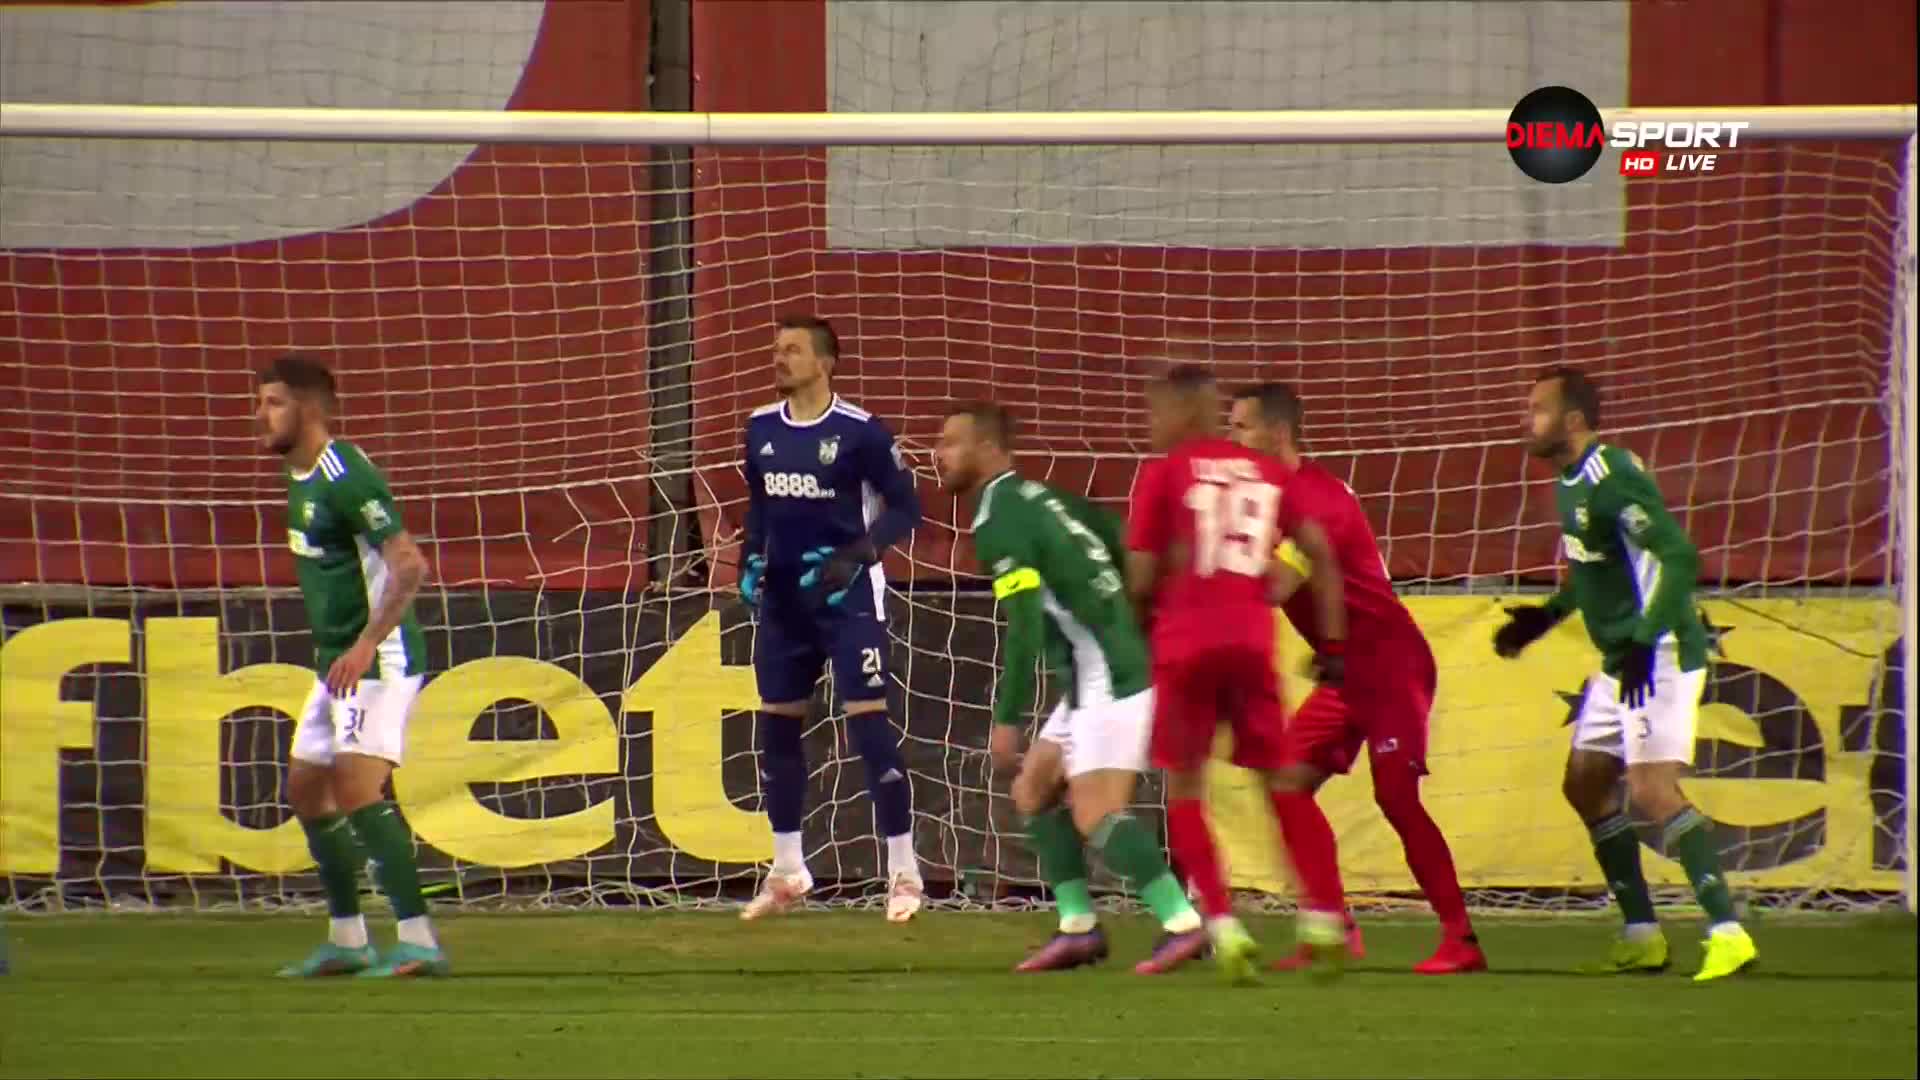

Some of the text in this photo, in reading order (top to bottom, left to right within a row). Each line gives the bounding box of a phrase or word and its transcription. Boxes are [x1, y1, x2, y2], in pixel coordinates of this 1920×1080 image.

[861, 647, 881, 673] 21
[344, 707, 366, 731] 31
[1637, 716, 1652, 739] 3
[0, 609, 775, 873] fbet
